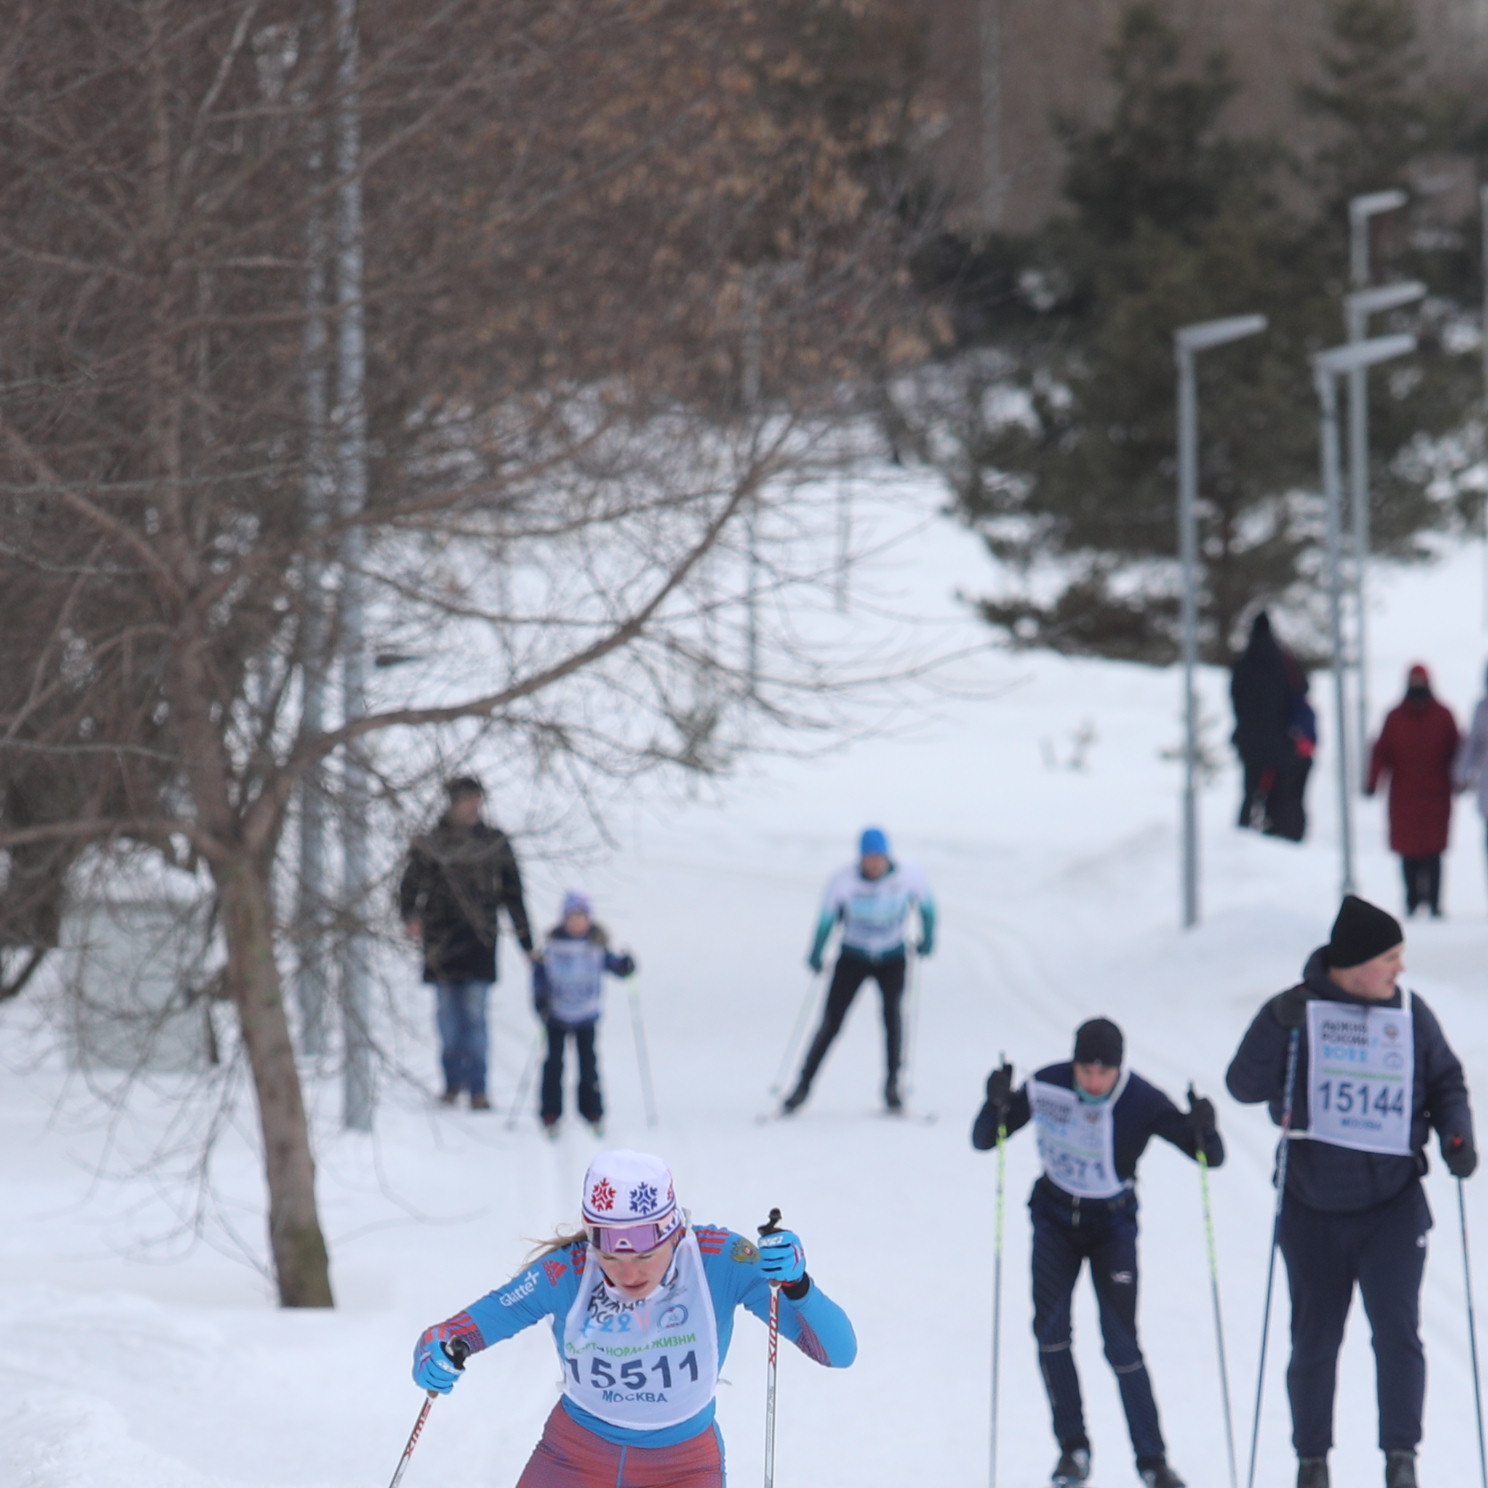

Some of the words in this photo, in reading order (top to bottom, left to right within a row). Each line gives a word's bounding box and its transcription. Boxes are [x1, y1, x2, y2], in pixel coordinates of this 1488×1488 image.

[1318, 1080, 1404, 1119] 15144
[650, 1333, 696, 1349] ЖИЗНИ
[566, 1350, 699, 1390] 15511
[602, 1389, 668, 1403] МОСКВА
